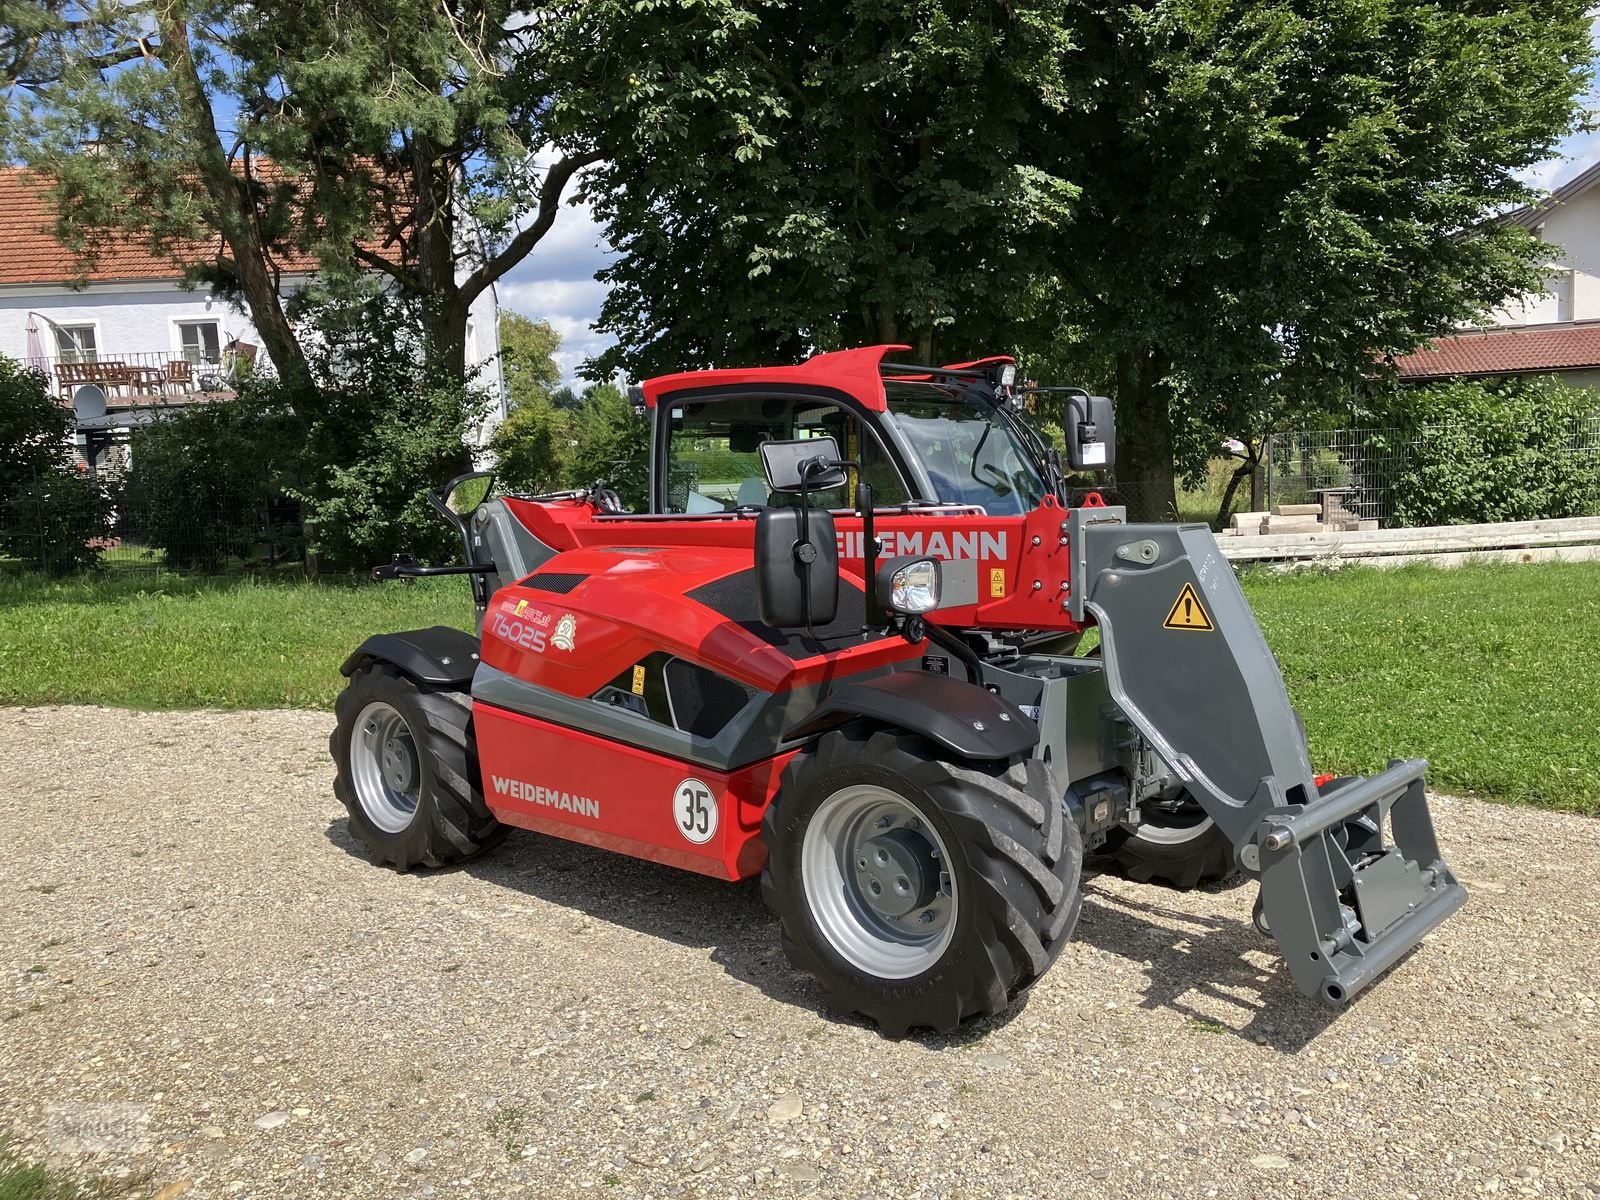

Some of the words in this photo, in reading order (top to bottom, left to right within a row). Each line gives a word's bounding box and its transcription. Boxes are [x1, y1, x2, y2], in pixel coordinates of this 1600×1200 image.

[836, 531, 1007, 560] EIEMANN
[492, 613, 547, 653] T6025
[491, 774, 600, 819] WEIDEMANN
[682, 787, 709, 834] 35
